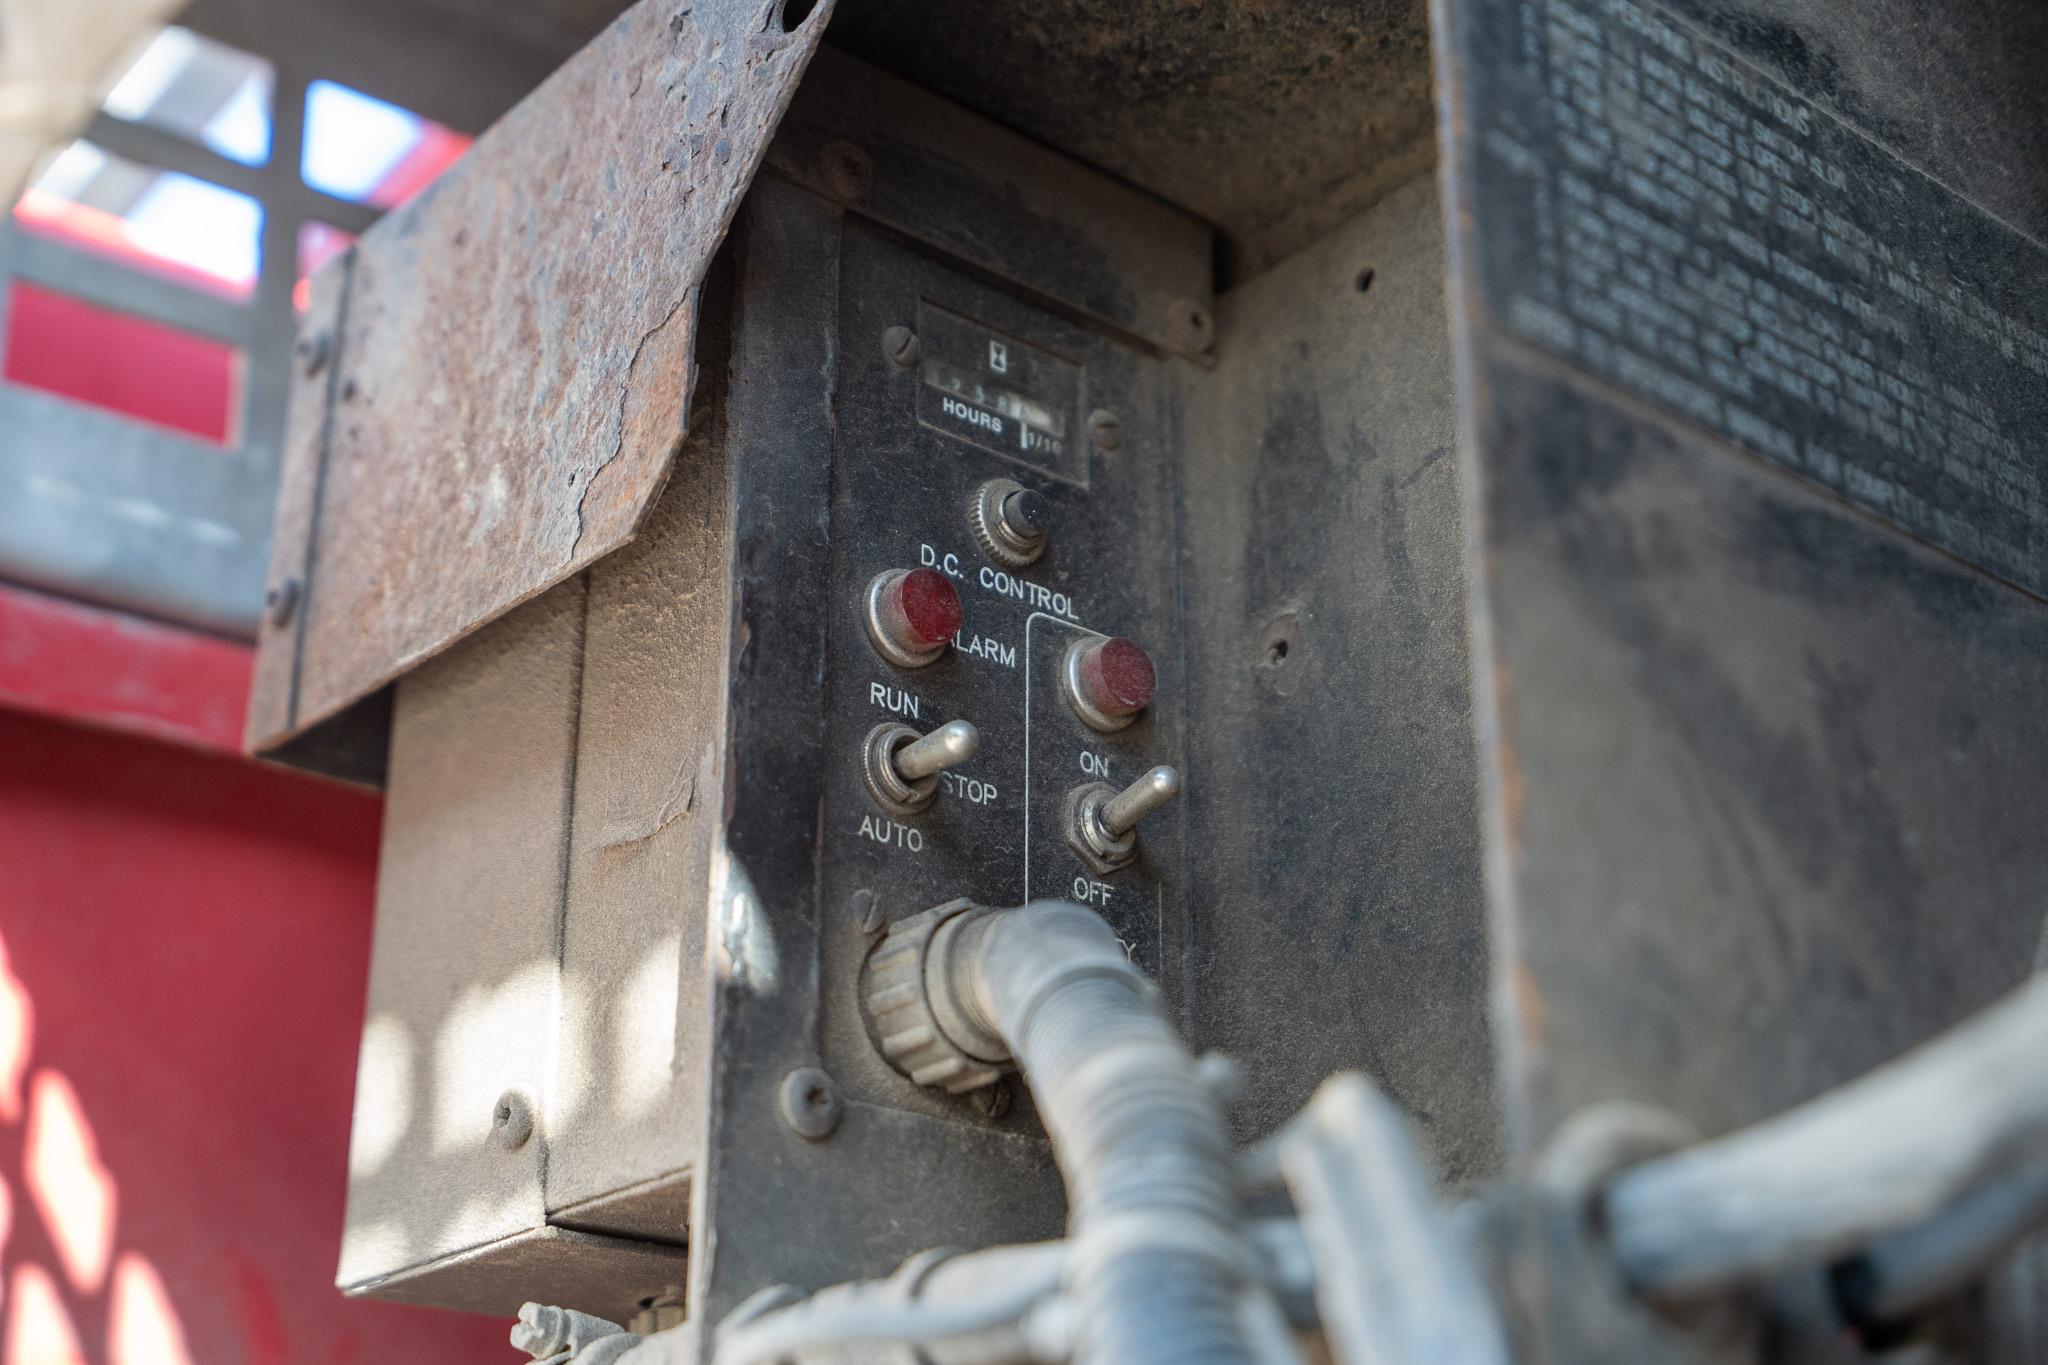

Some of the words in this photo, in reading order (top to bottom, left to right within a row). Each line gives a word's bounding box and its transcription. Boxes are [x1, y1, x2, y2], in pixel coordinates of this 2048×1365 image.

[942, 396, 1003, 435] HOURS
[920, 543, 964, 579] D.C.
[979, 566, 1079, 620] CONTROL
[870, 682, 920, 719] RUN
[1079, 750, 1109, 778] ON
[941, 770, 998, 806] STOP
[858, 815, 923, 852] AUTO
[1073, 876, 1115, 906] OFF
